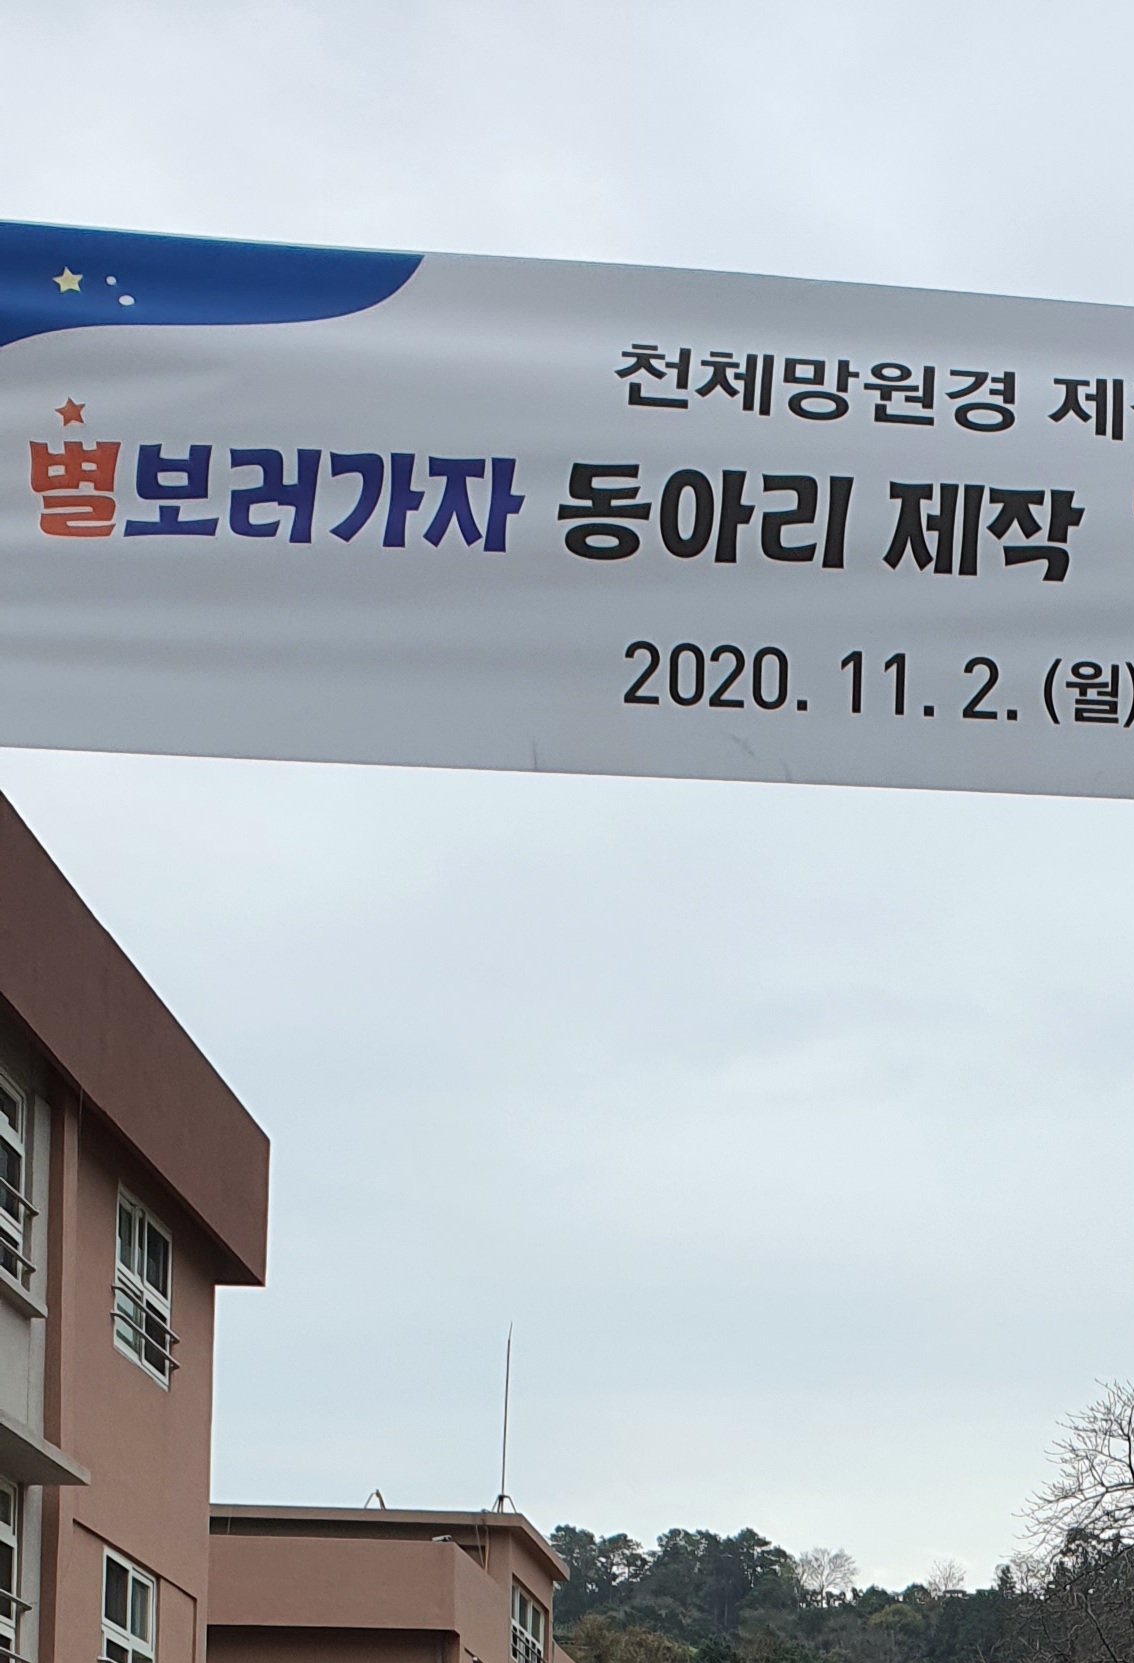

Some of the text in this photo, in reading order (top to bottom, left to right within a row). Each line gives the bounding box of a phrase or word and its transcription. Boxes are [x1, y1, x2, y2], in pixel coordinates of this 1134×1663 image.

[614, 343, 1017, 434] 천체망원경
[30, 442, 525, 553] 별보러가자
[557, 462, 856, 571] 동아리
[882, 480, 1087, 584] 제작
[623, 640, 809, 713] 2020.
